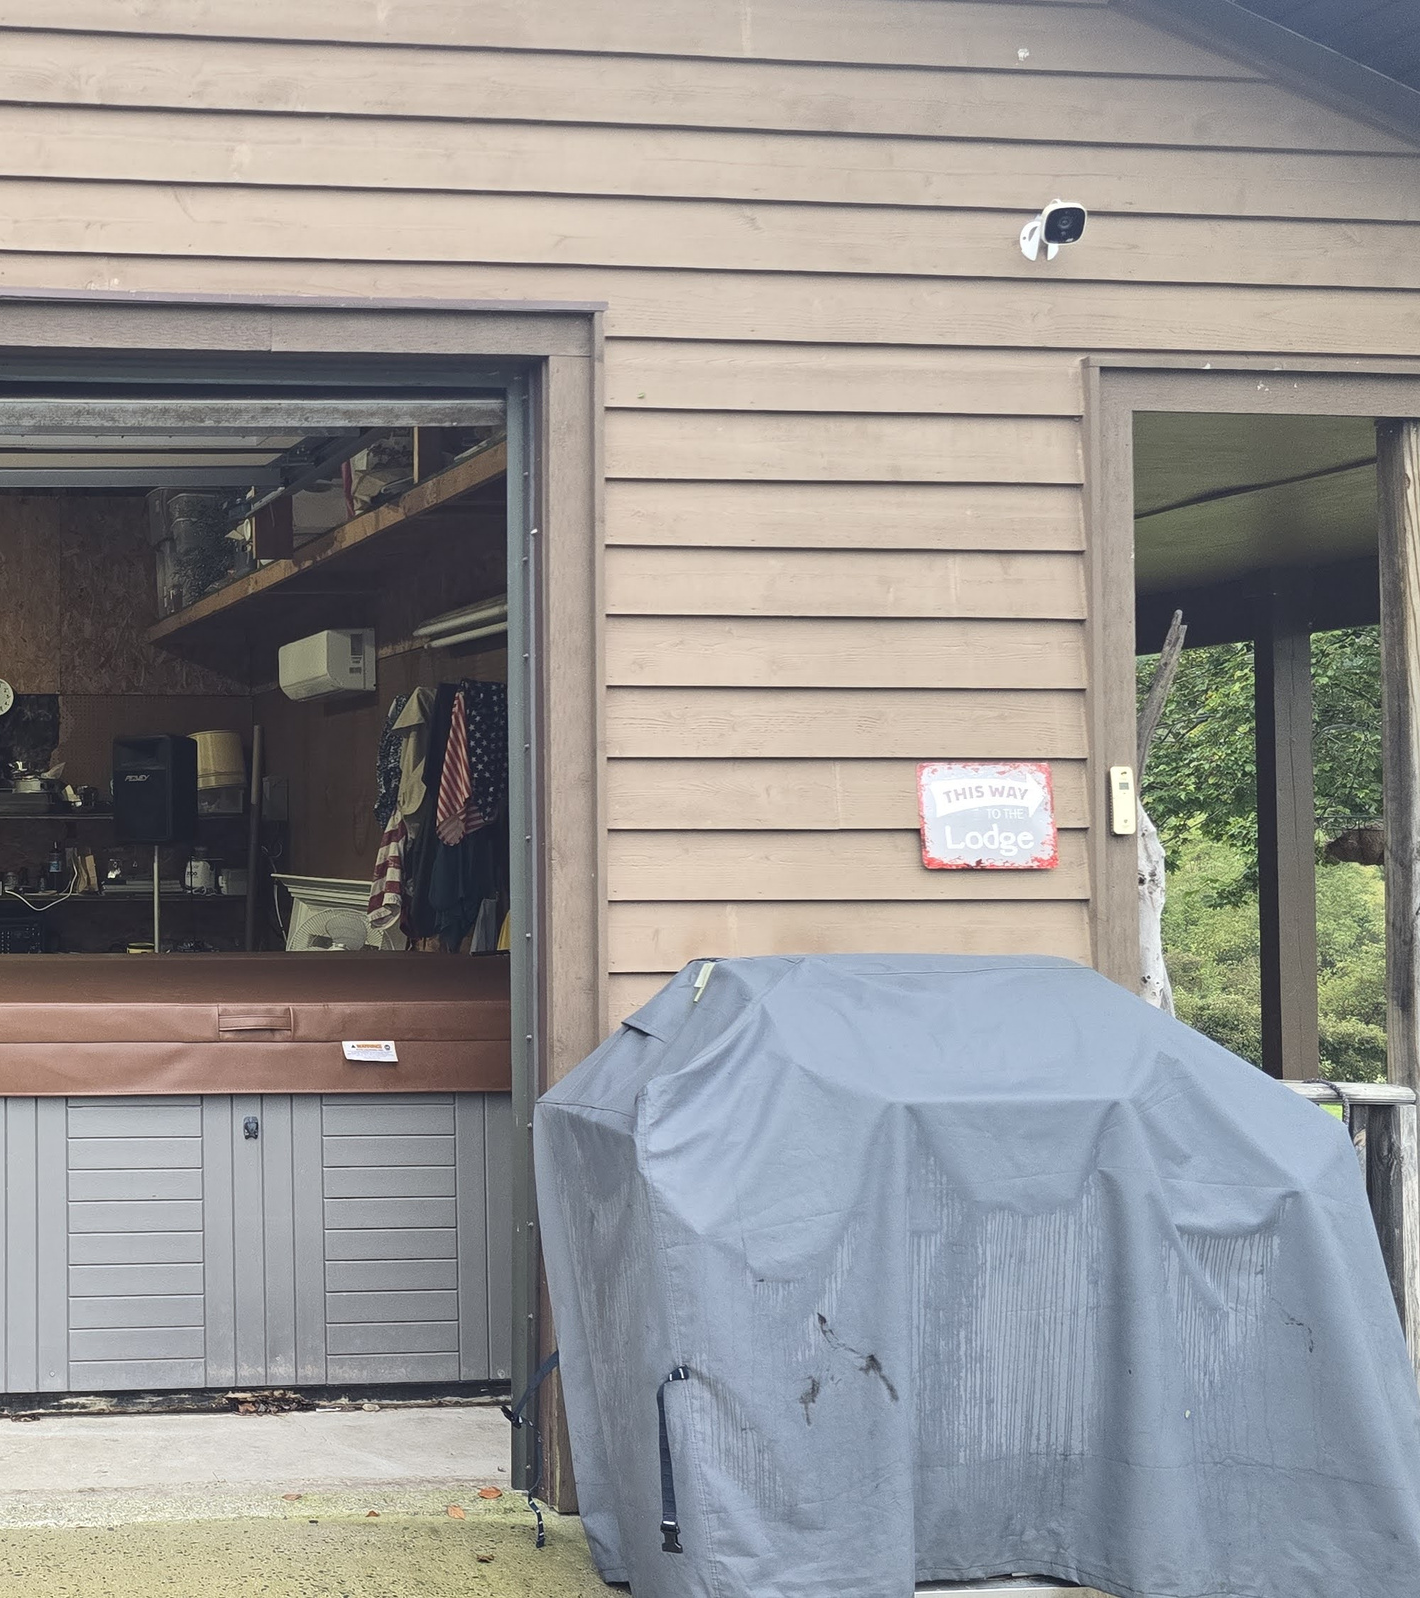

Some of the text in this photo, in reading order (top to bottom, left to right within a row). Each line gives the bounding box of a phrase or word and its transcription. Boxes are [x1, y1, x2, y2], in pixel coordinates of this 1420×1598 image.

[942, 784, 1029, 803] THIS WAY
[986, 808, 1025, 819] TO THE
[944, 823, 1035, 857] Lodge
